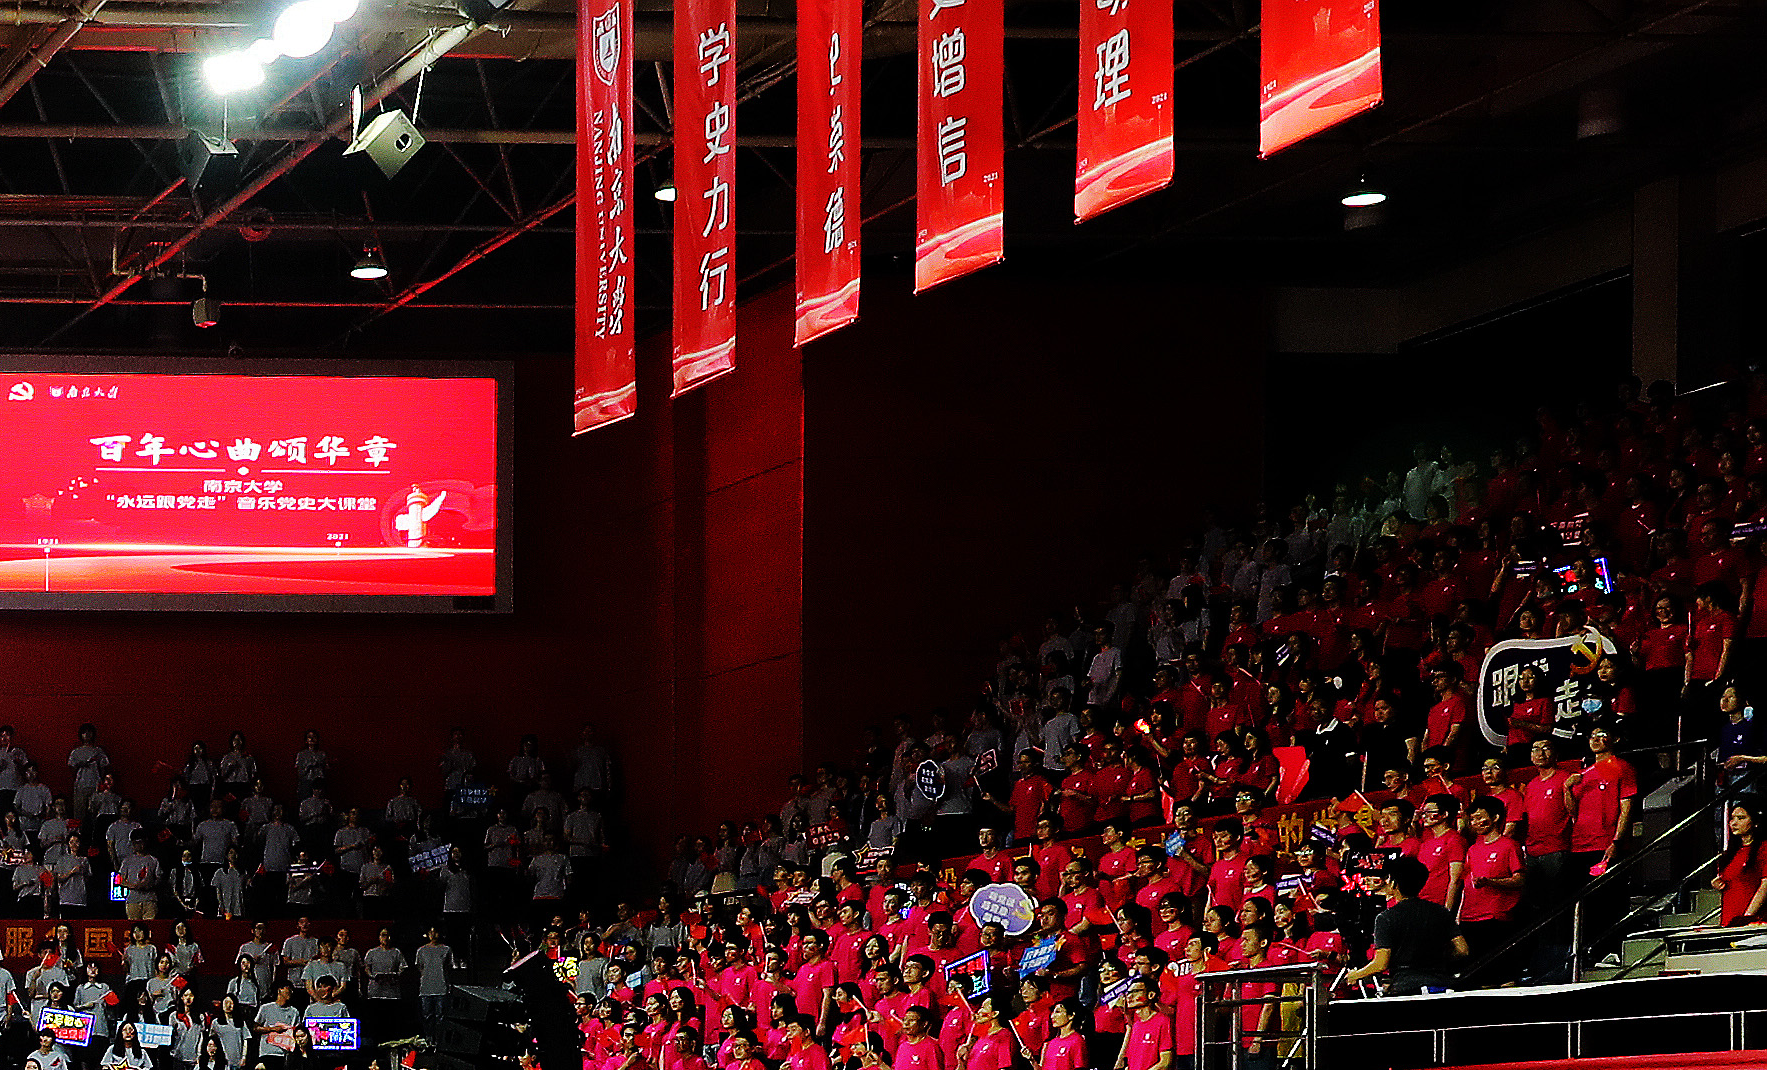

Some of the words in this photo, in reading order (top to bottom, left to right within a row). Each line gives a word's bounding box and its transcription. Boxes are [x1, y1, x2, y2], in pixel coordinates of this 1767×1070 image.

[929, 0, 966, 188] 增信
[594, 110, 604, 205] NANJING
[698, 22, 731, 312] 学史力行
[595, 211, 608, 339] UNIVERSITY
[90, 432, 397, 467] 百年心曲颂华章
[203, 479, 283, 494] 南京大学
[237, 495, 377, 511] 音乐党史大课堂
